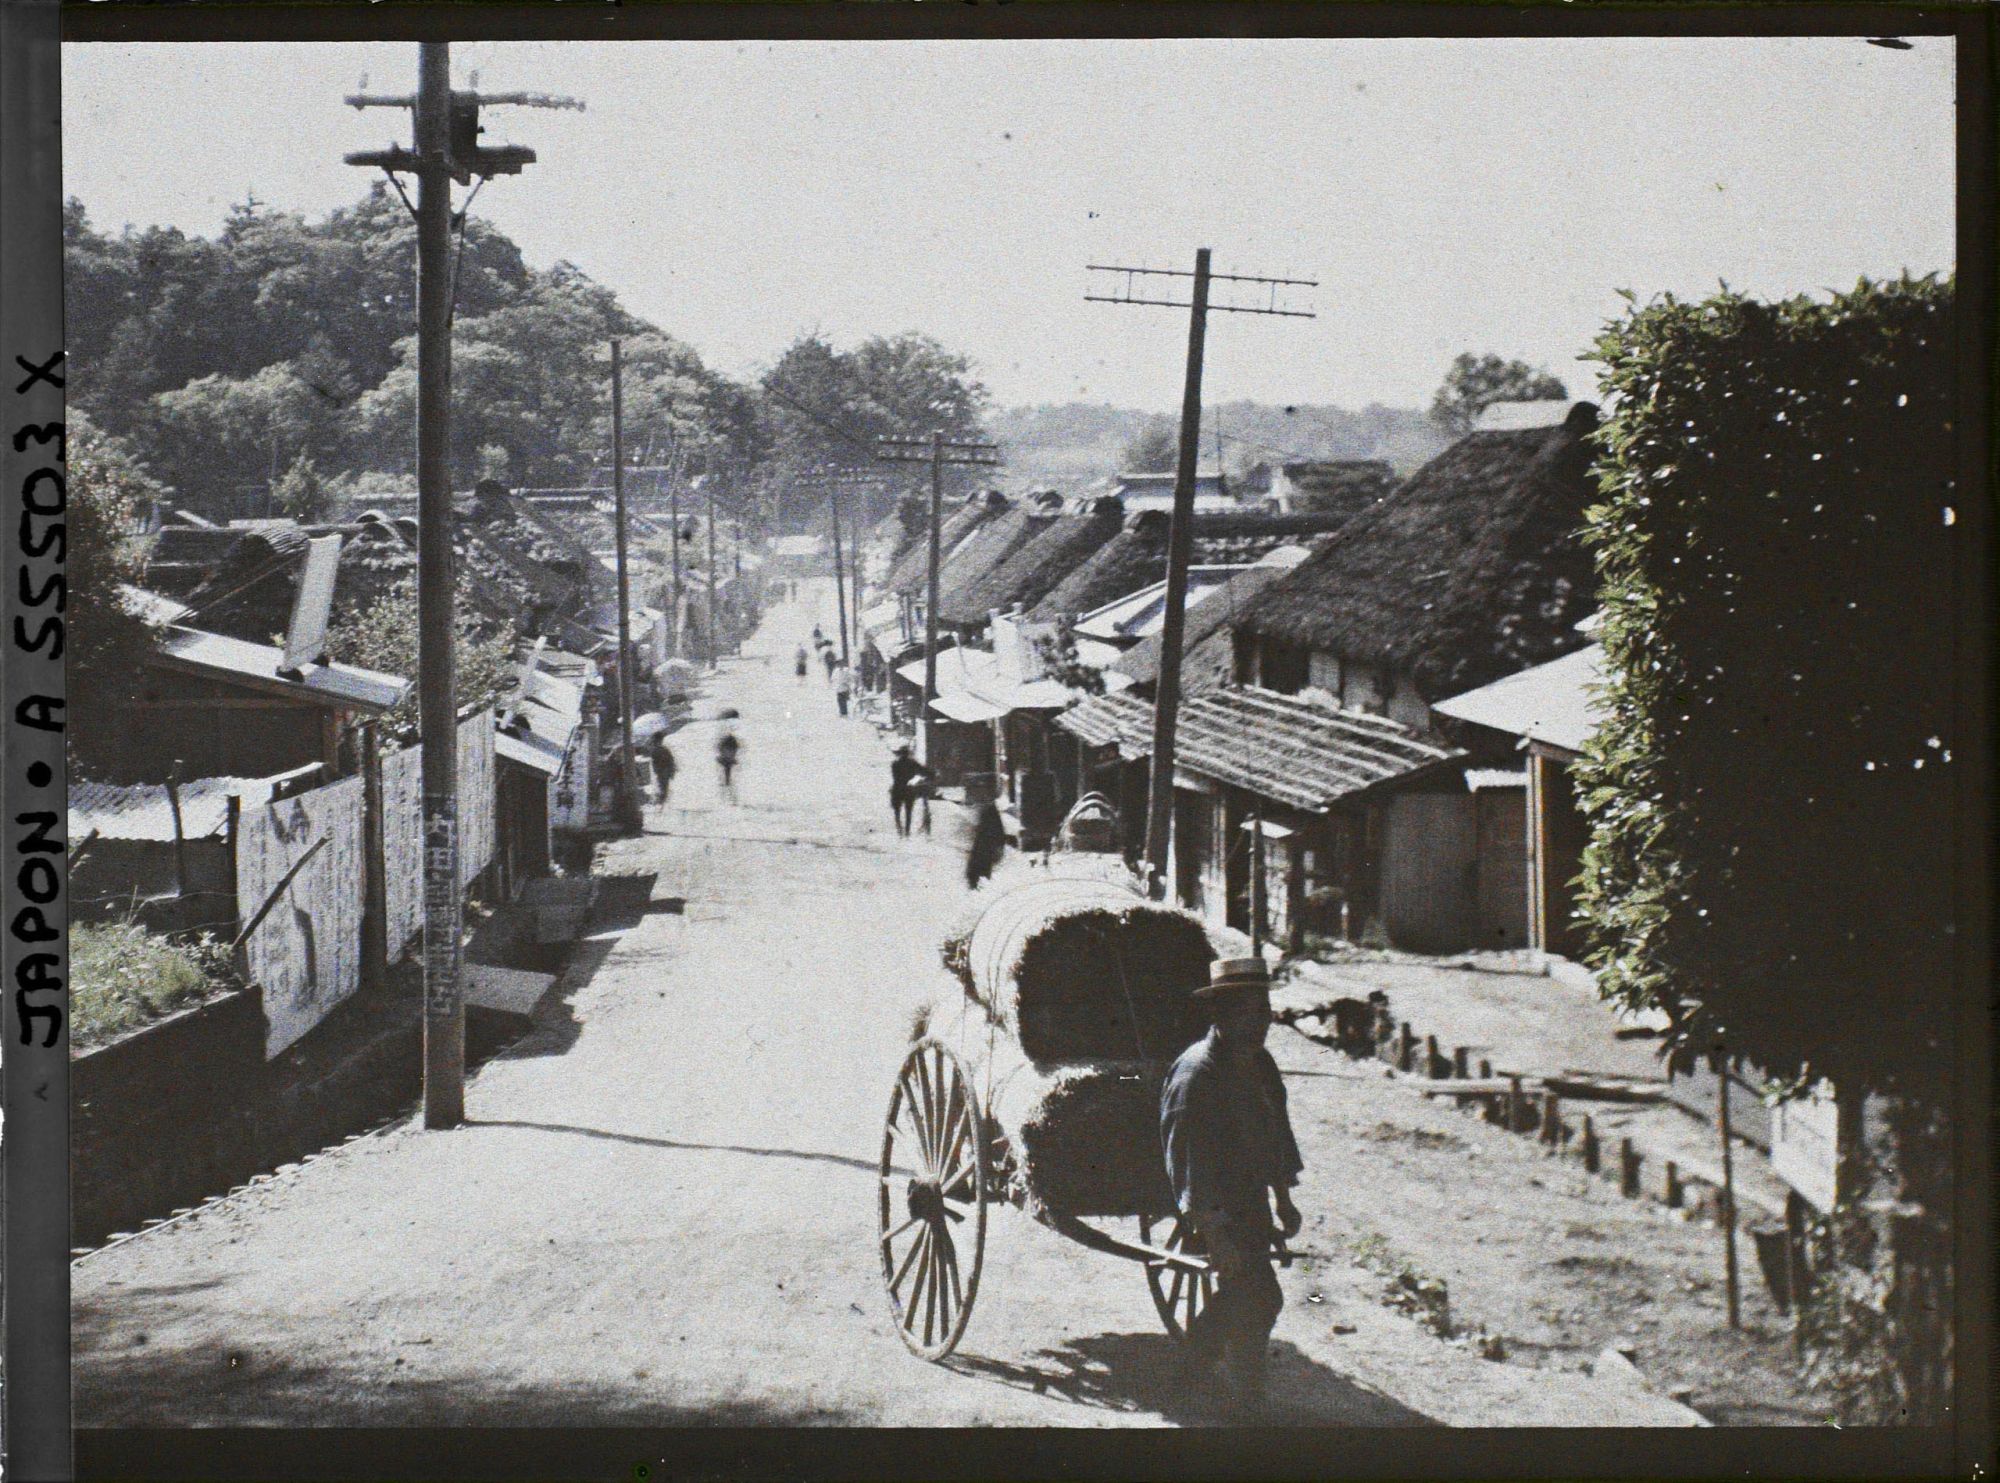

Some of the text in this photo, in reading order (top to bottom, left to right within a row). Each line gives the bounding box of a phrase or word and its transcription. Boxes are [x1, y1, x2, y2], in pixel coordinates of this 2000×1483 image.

[15, 351, 65, 394] X
[14, 695, 65, 734] A
[10, 812, 63, 1048] JAPON
